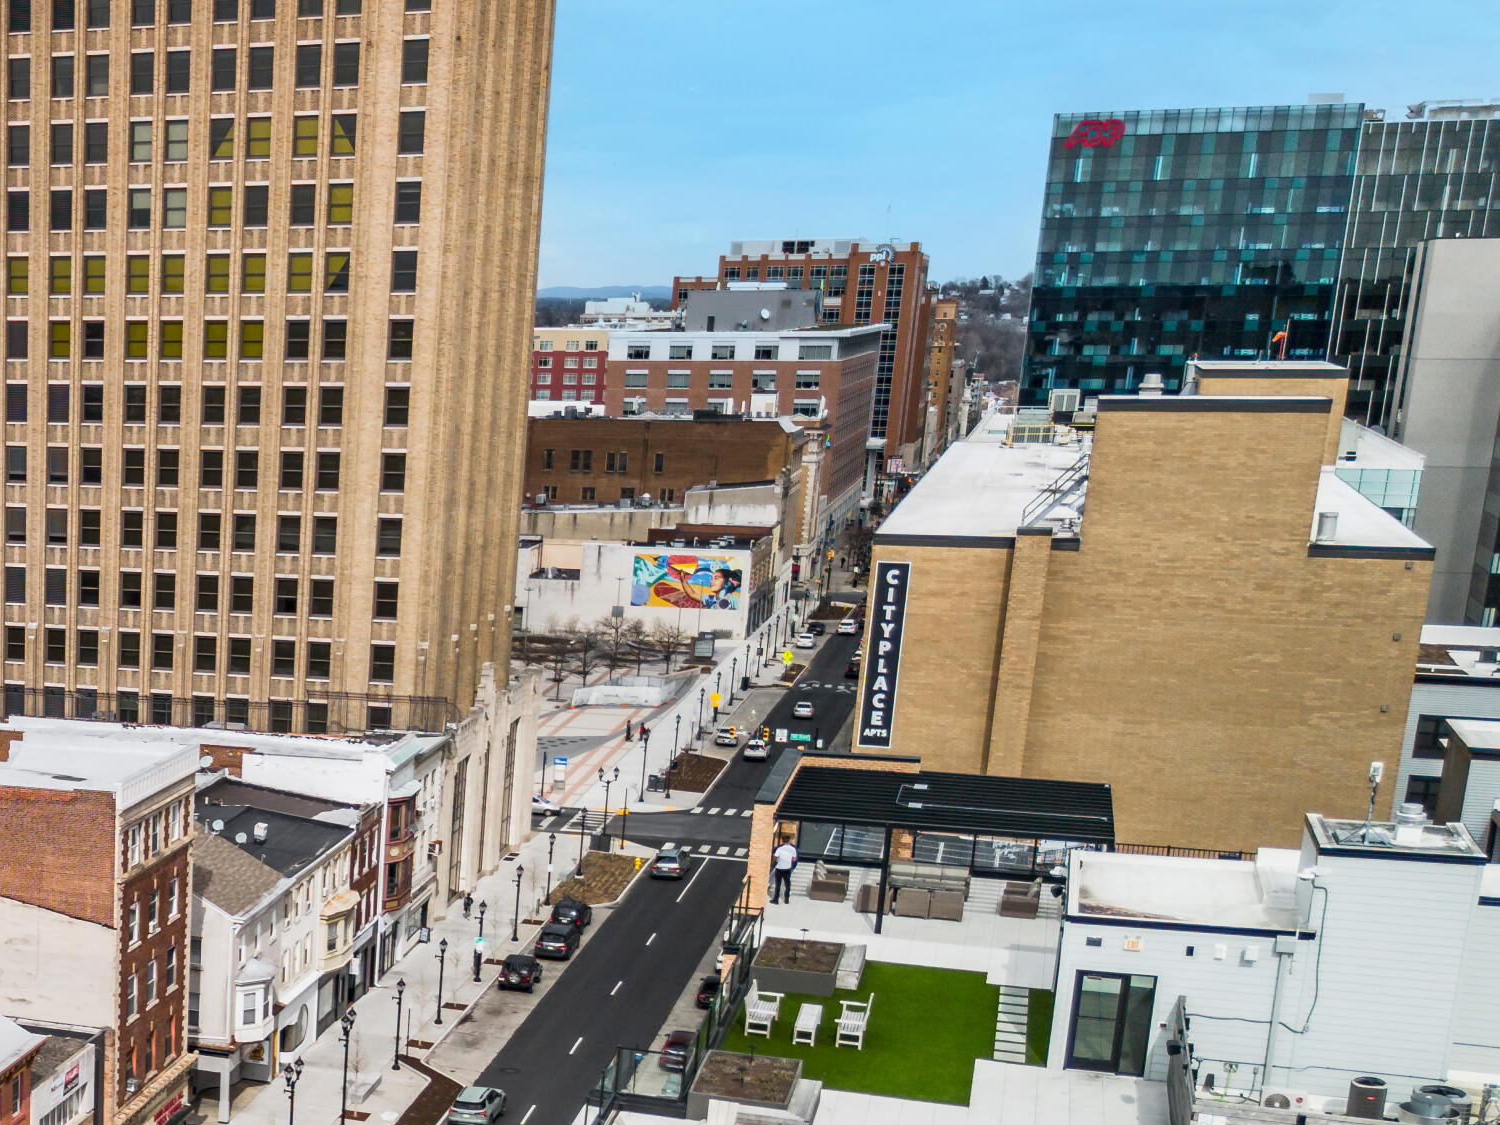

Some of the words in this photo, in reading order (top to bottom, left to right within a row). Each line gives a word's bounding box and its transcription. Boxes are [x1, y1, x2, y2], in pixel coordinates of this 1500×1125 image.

[1062, 120, 1125, 148] ADP
[869, 250, 887, 262] ppl
[871, 569, 900, 726] CITYPLACE
[863, 728, 888, 737] APTS
